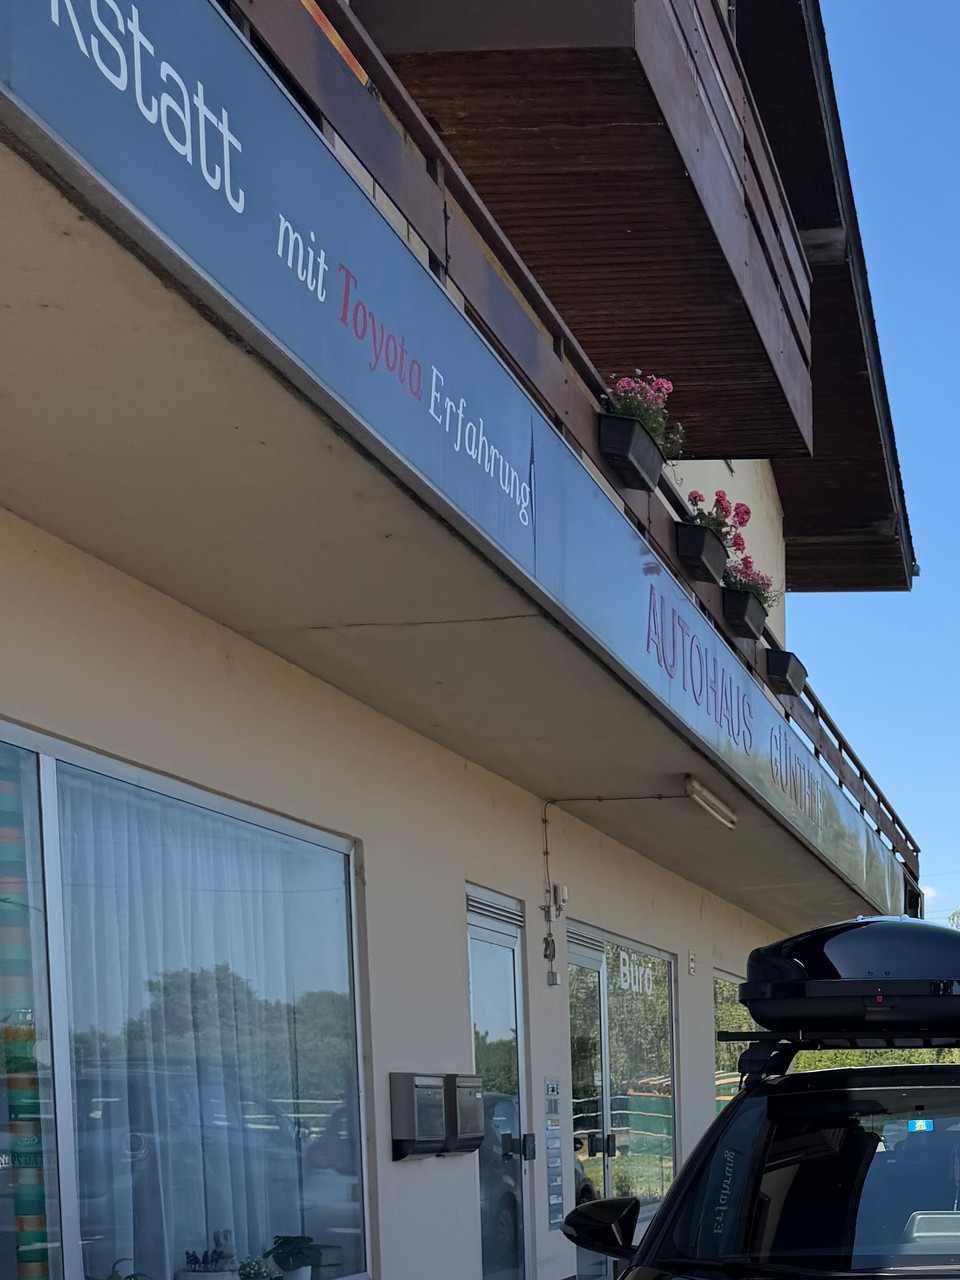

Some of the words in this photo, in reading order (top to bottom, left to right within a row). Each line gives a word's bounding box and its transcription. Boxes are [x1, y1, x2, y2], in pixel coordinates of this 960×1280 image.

[276, 213, 329, 303] mit
[338, 262, 424, 402] Toyota
[427, 364, 531, 526] Erfahrung
[646, 583, 754, 757] AUTOHAUS
[620, 950, 653, 996] Büro
